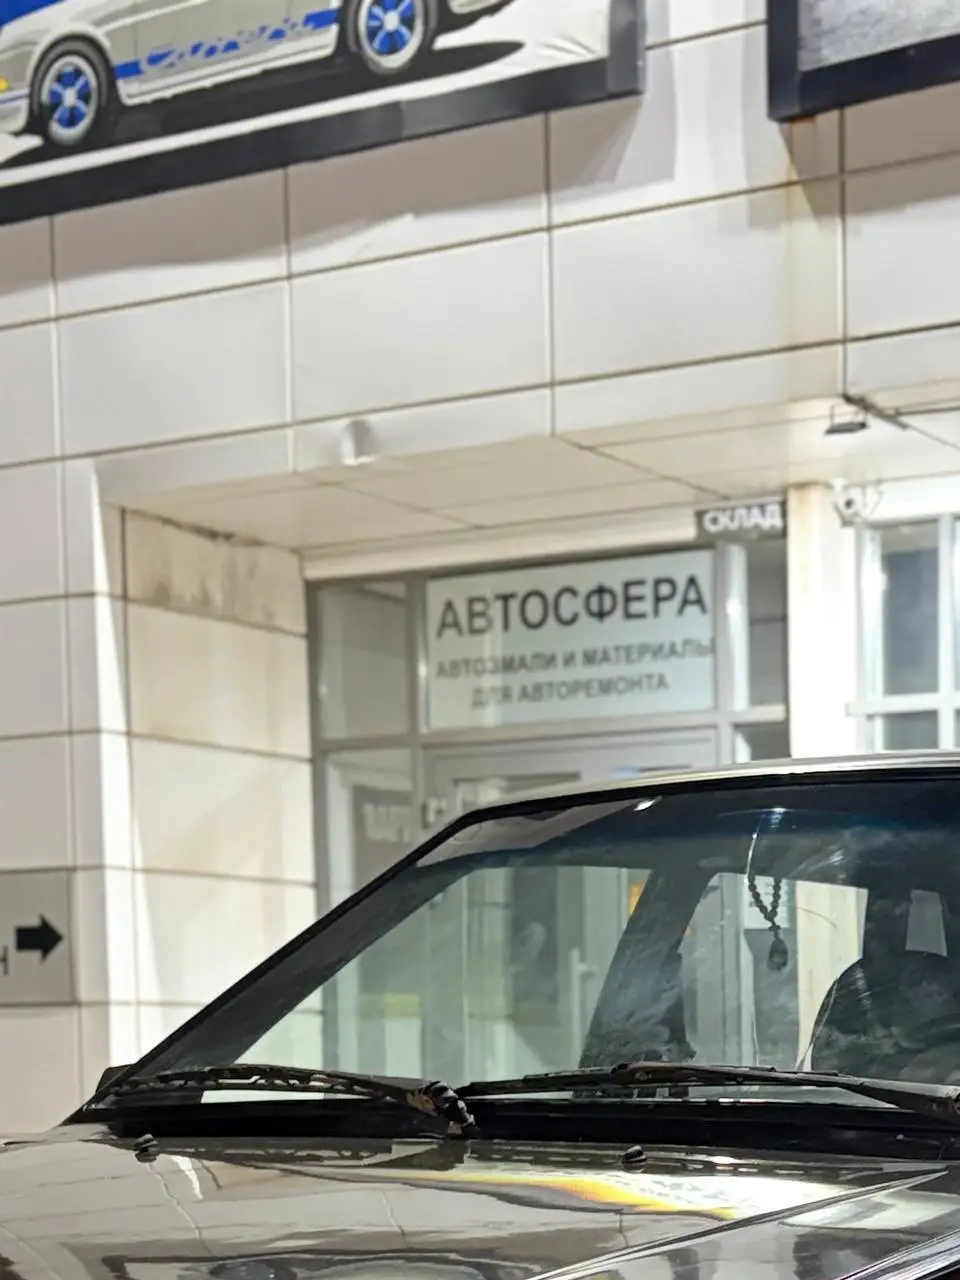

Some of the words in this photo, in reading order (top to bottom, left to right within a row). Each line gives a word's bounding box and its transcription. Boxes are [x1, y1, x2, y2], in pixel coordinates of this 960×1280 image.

[703, 503, 784, 533] СКЛАД
[435, 574, 708, 639] АВТОСФЕРА
[434, 648, 557, 679] АВТОЭМАЛИ
[562, 648, 578, 669] И
[582, 636, 715, 667] МАТЕРИАЛЫ
[517, 672, 670, 703] АВТОРЕМОНТА
